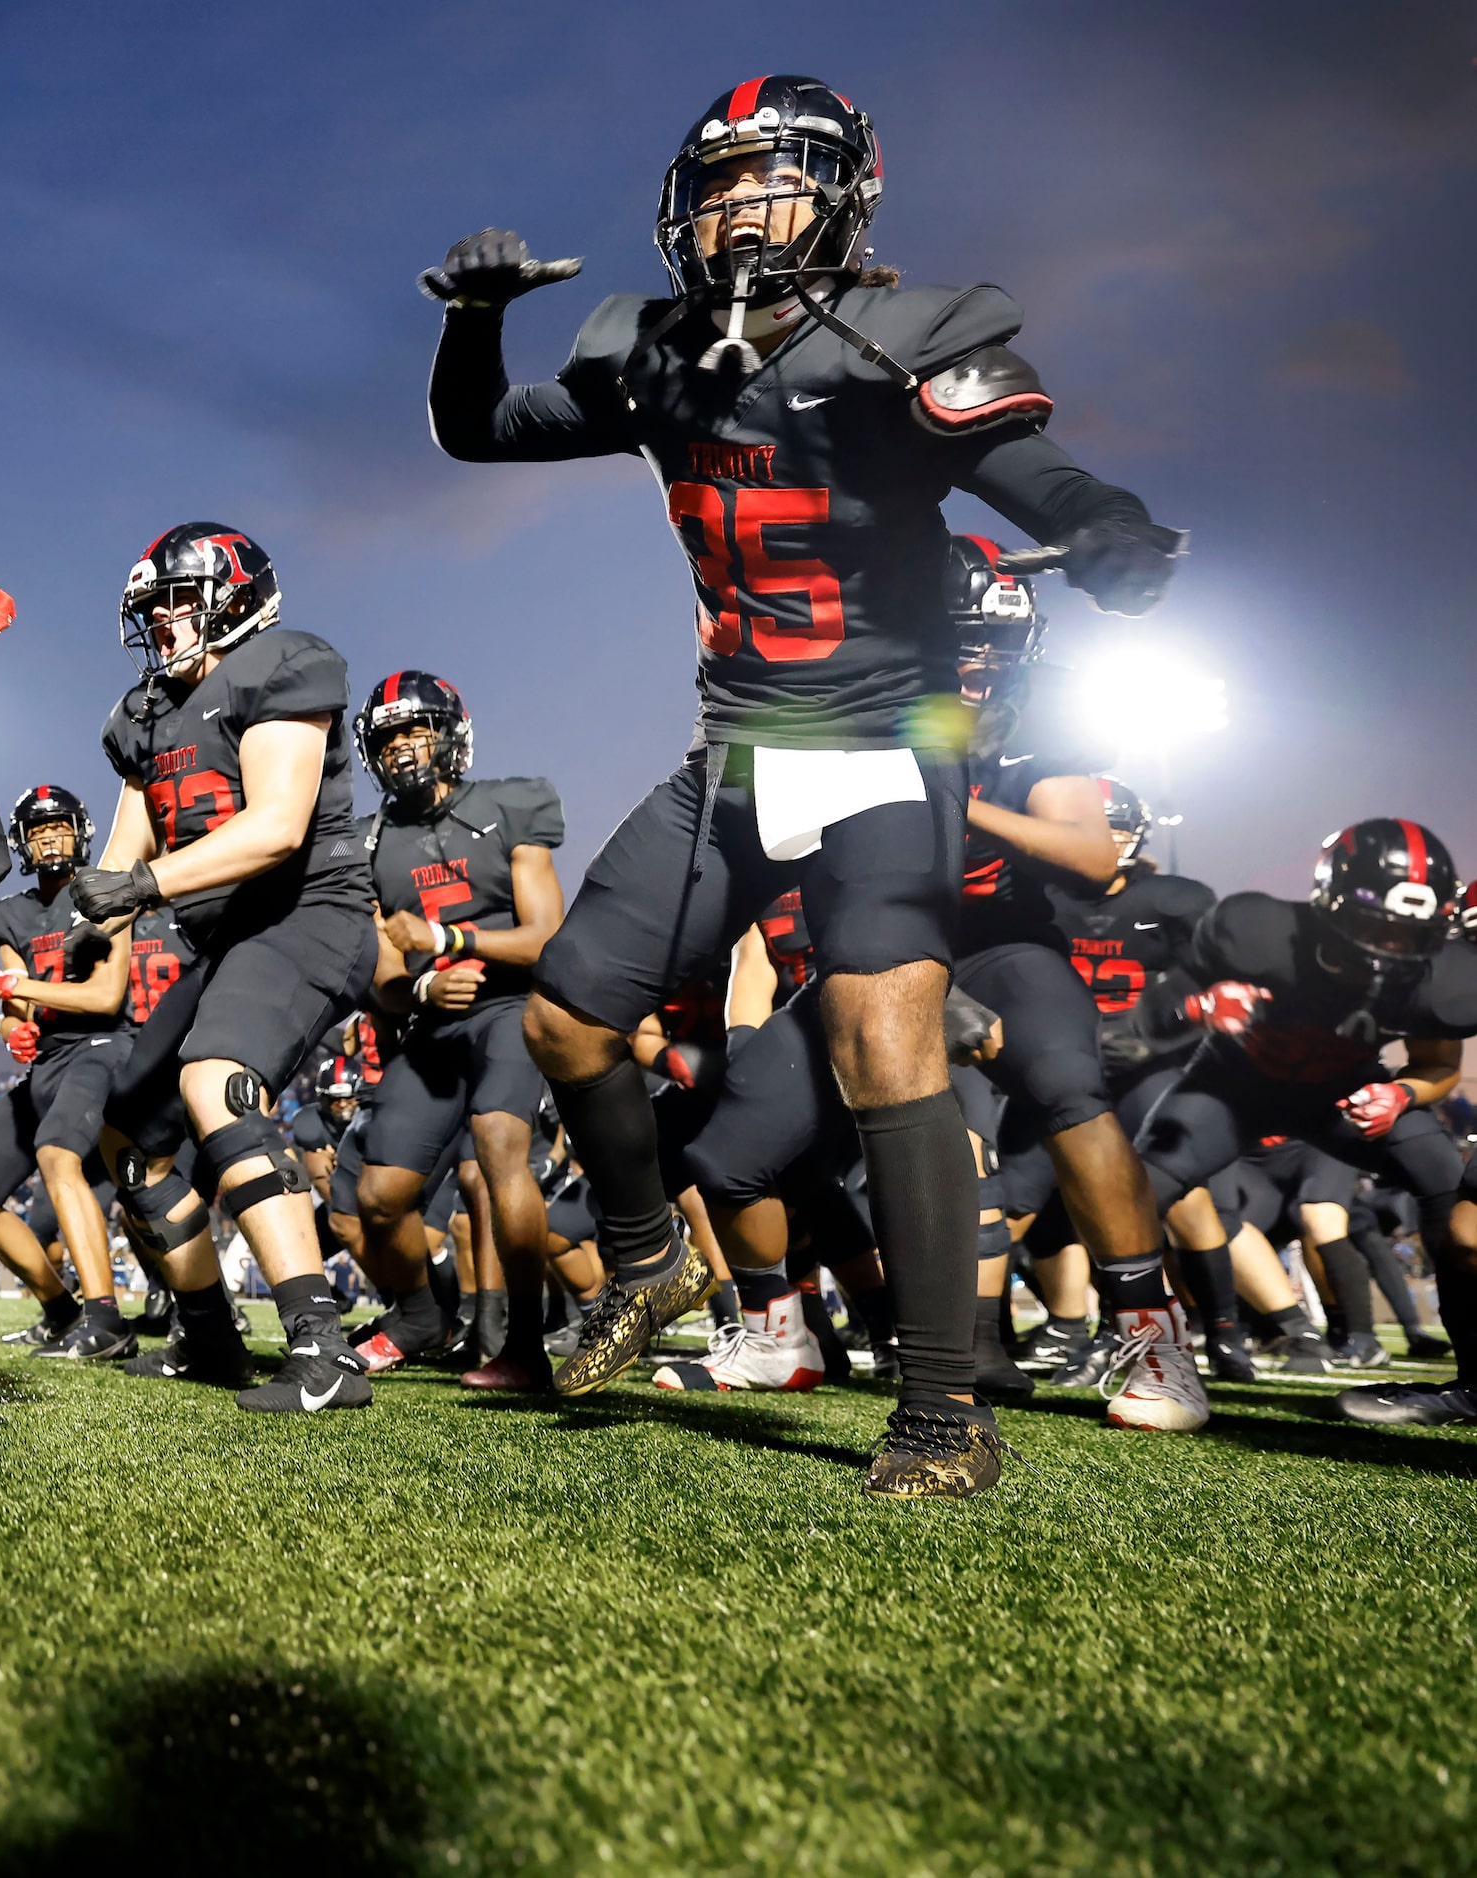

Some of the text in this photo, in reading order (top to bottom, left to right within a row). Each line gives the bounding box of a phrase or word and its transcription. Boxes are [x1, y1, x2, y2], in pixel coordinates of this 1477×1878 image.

[688, 442, 775, 481] TRINITY
[190, 533, 255, 585] T
[668, 480, 845, 663] 35
[411, 857, 468, 888] TRINITY
